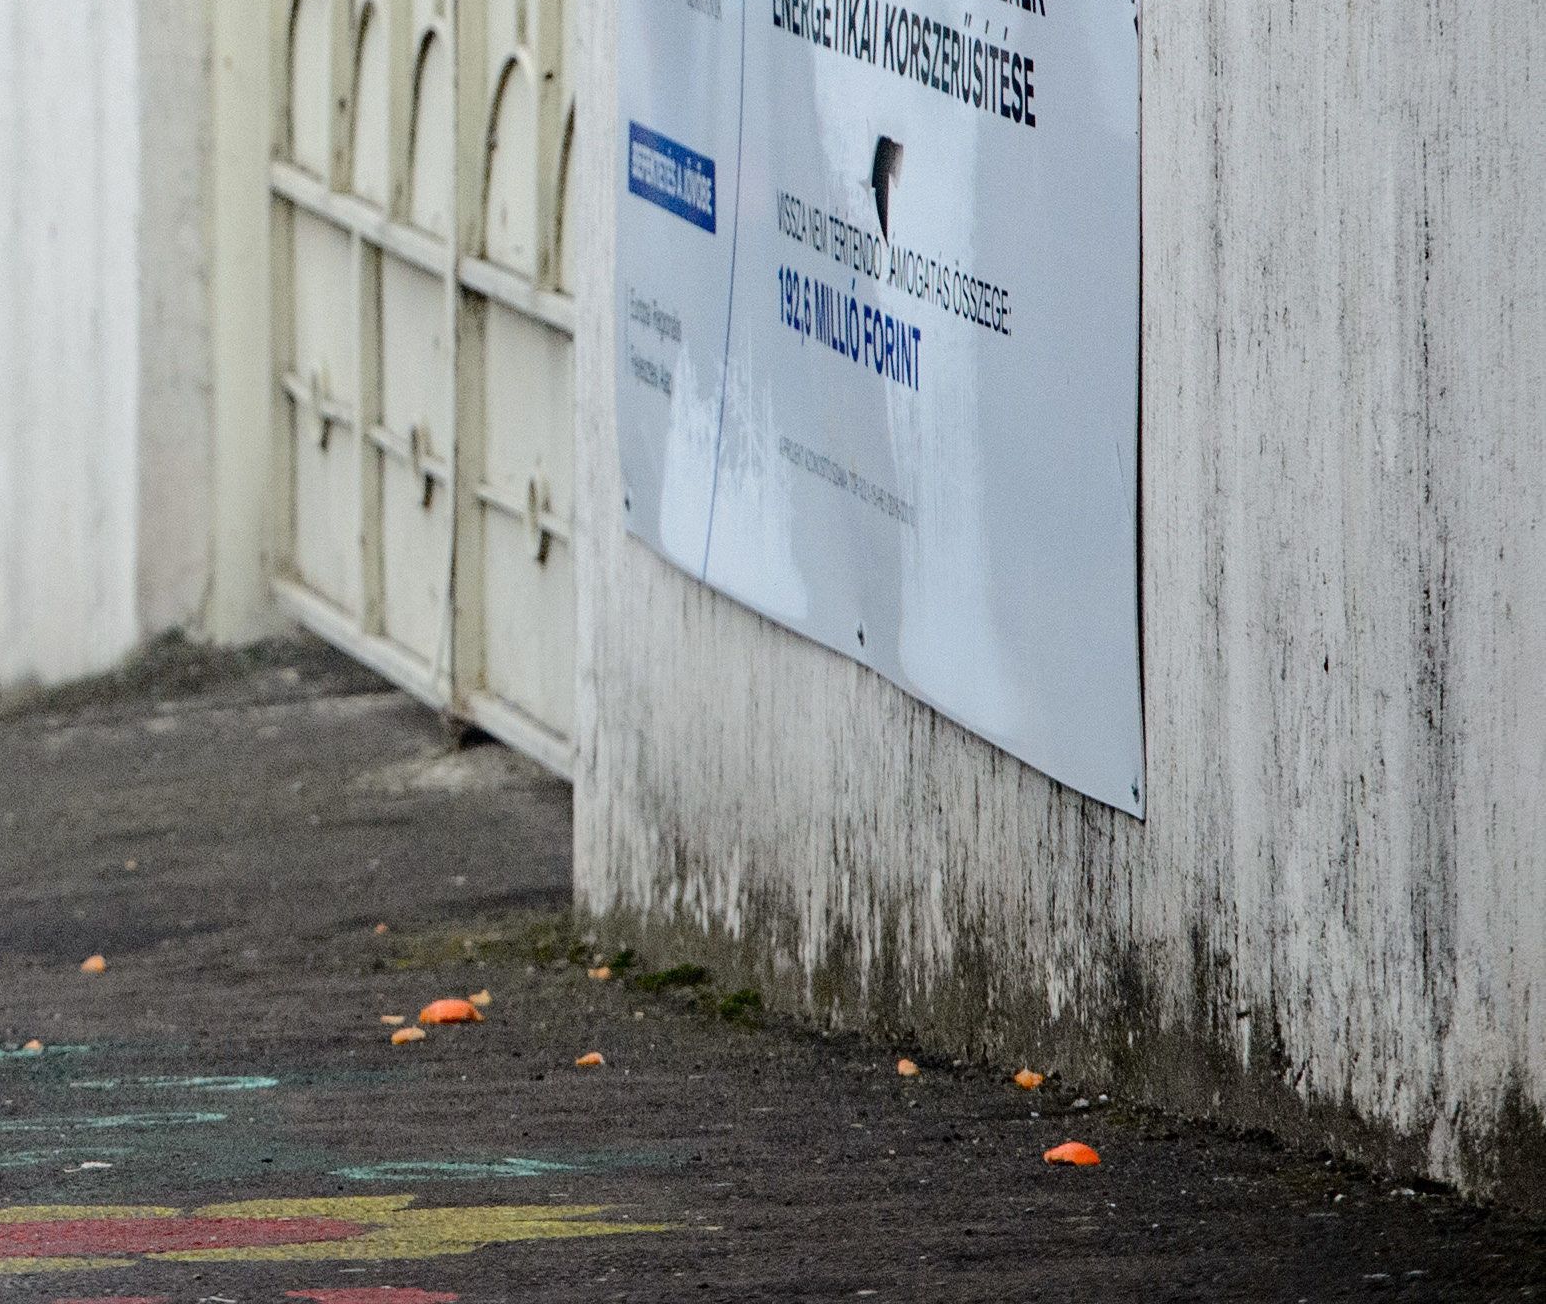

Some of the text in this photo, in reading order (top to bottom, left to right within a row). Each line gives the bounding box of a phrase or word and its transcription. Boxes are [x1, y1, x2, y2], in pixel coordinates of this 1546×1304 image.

[882, 12, 1037, 129] KORSZERŰSÍTÉSE
[776, 187, 807, 244] VISSZA
[808, 204, 828, 255] NEM
[952, 259, 1012, 337] ÖSSZEGE:
[778, 263, 812, 347] 192,6
[814, 276, 860, 363] MILLIÓ
[863, 303, 921, 392] FORINT
